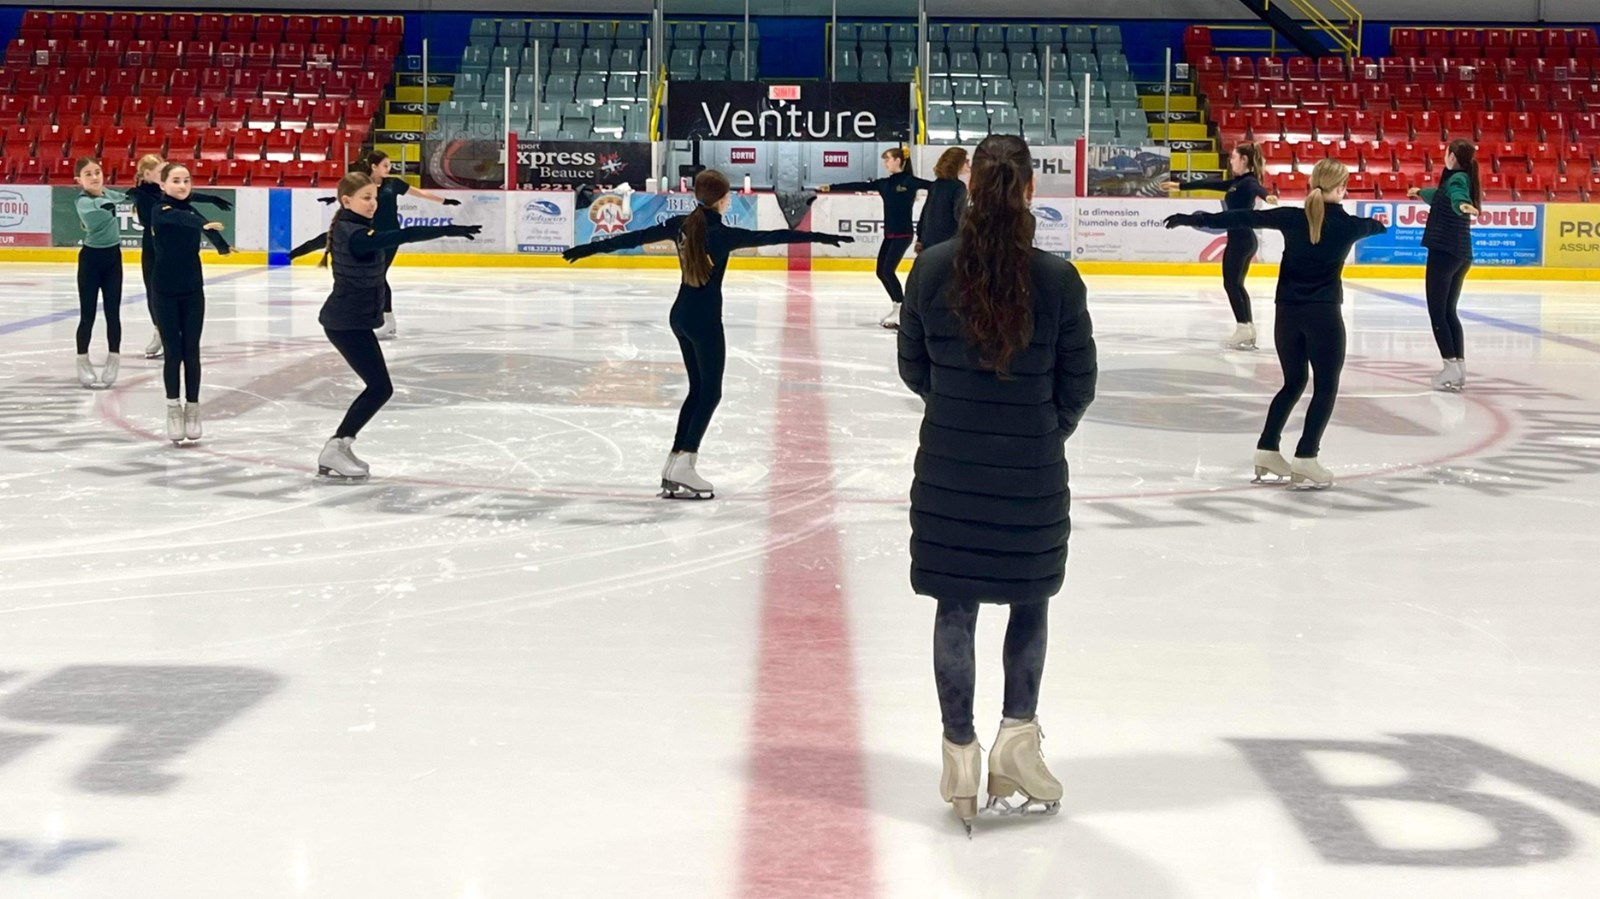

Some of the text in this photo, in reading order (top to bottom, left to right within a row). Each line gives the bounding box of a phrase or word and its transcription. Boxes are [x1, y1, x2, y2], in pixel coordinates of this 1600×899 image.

[701, 101, 877, 138] Venture
[516, 151, 597, 169] xpress
[732, 152, 755, 160] SORTIE
[824, 155, 848, 163] SORTIE
[540, 167, 595, 179] Beauce
[1078, 208, 1140, 217] La dimension
[1472, 207, 1535, 227] outu
[1078, 219, 1119, 228] humaine
[1121, 219, 1138, 228] des
